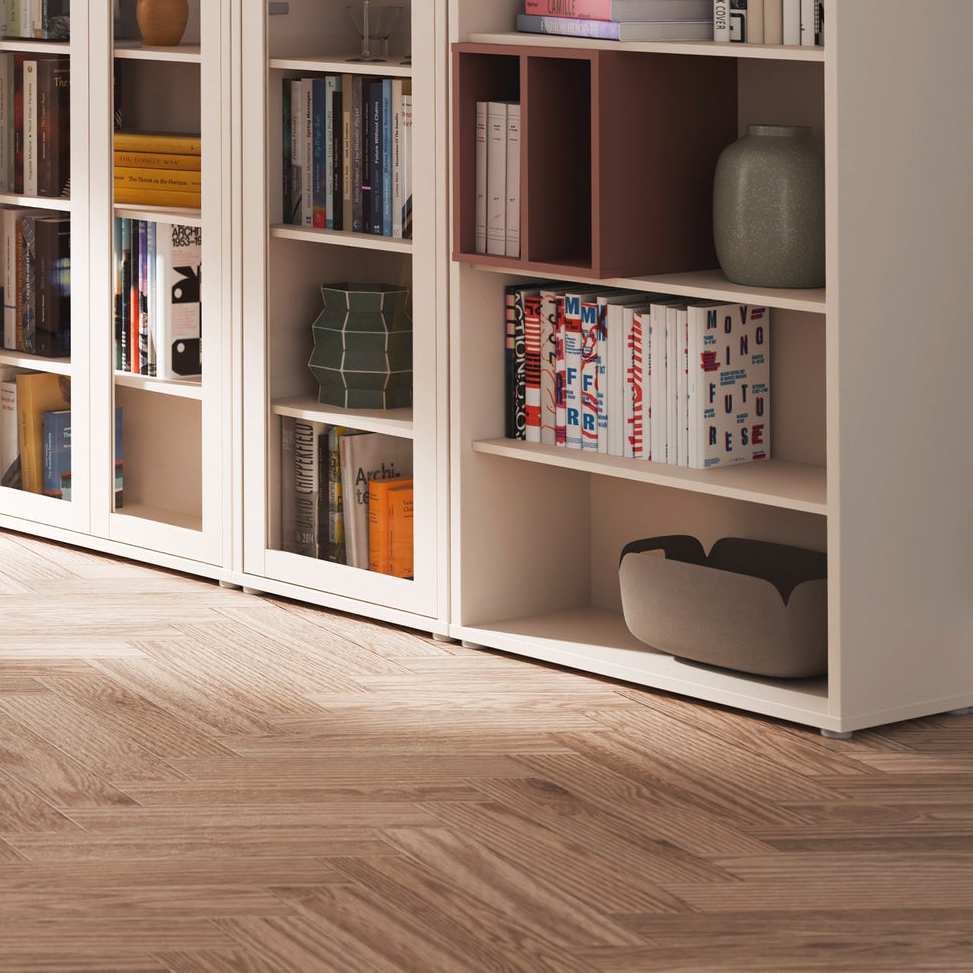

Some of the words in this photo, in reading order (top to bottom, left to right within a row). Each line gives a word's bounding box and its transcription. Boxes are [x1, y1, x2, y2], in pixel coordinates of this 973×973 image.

[715, 6, 726, 30] COVER
[295, 422, 314, 495] CHIPPERFIELD
[355, 462, 401, 486] Archi-
[295, 498, 314, 529] DAVID
